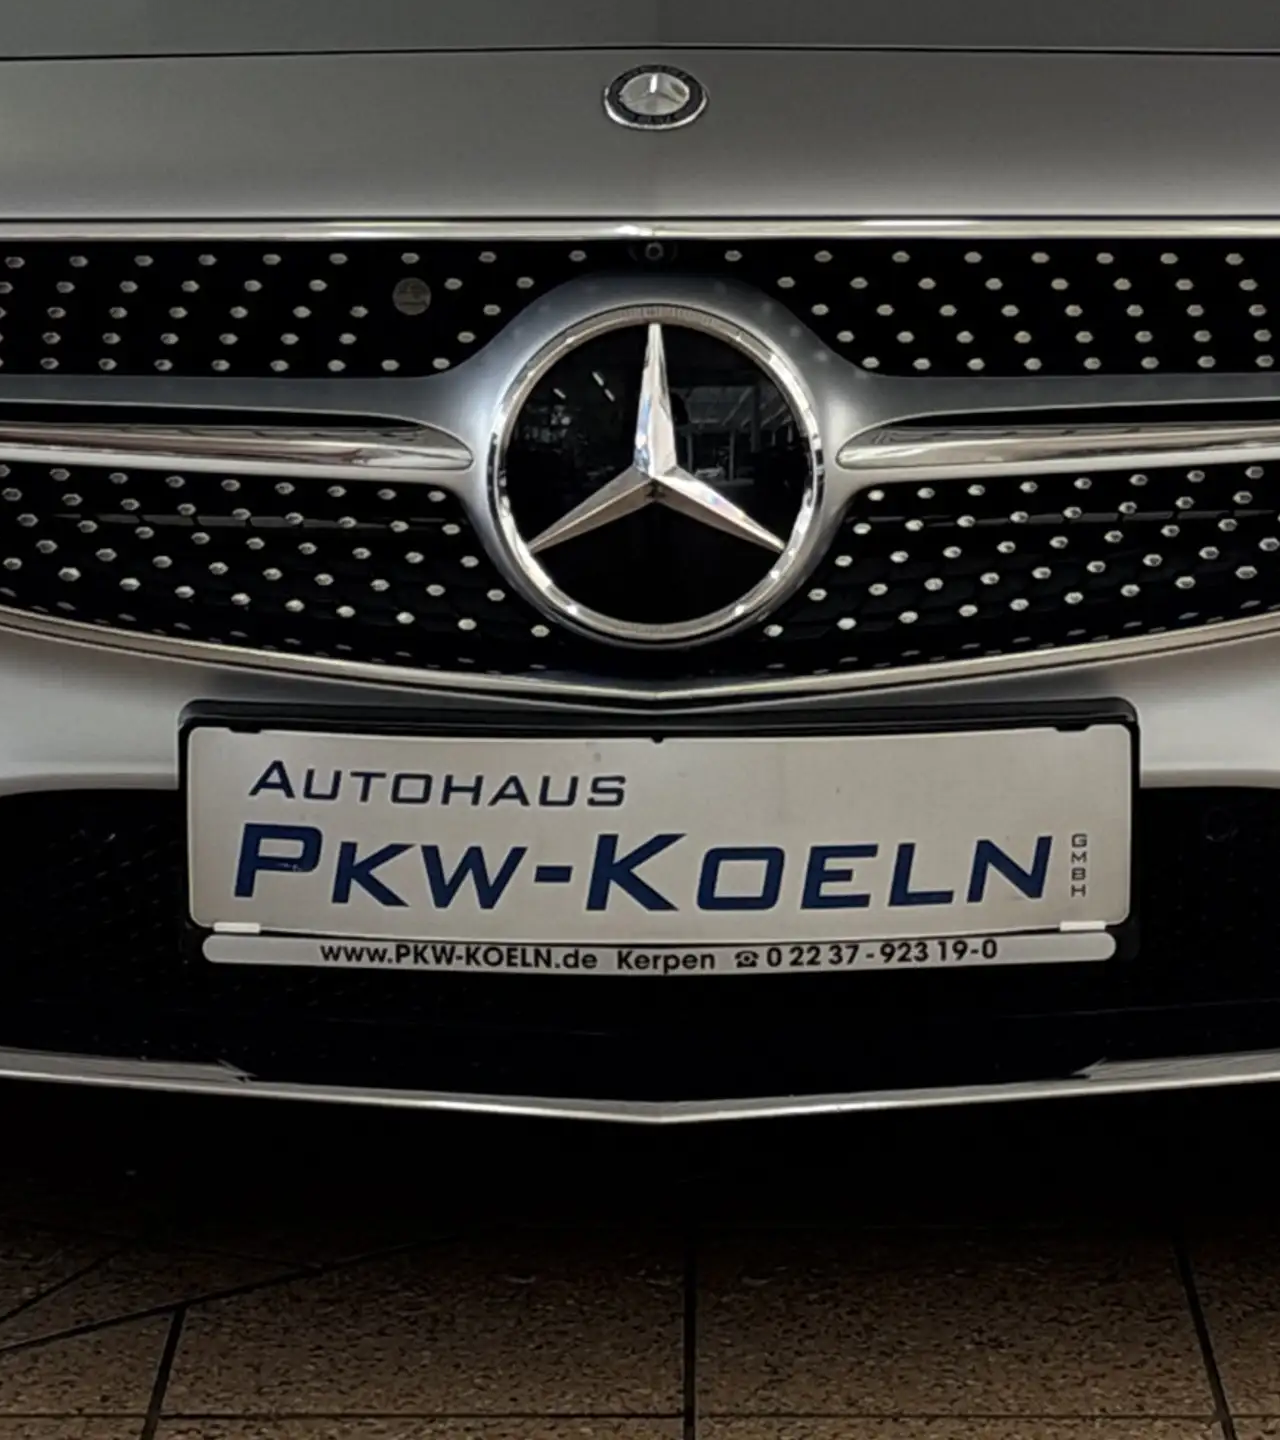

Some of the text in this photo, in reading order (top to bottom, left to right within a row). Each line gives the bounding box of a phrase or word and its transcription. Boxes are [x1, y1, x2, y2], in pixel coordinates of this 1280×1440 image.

[249, 759, 627, 807] AUTOHAUS
[233, 822, 1053, 912] PKW-KOELN
[1070, 833, 1088, 898] GMBH
[319, 943, 598, 970] www.PKW-KOELN.de
[616, 950, 716, 974] Kerpen
